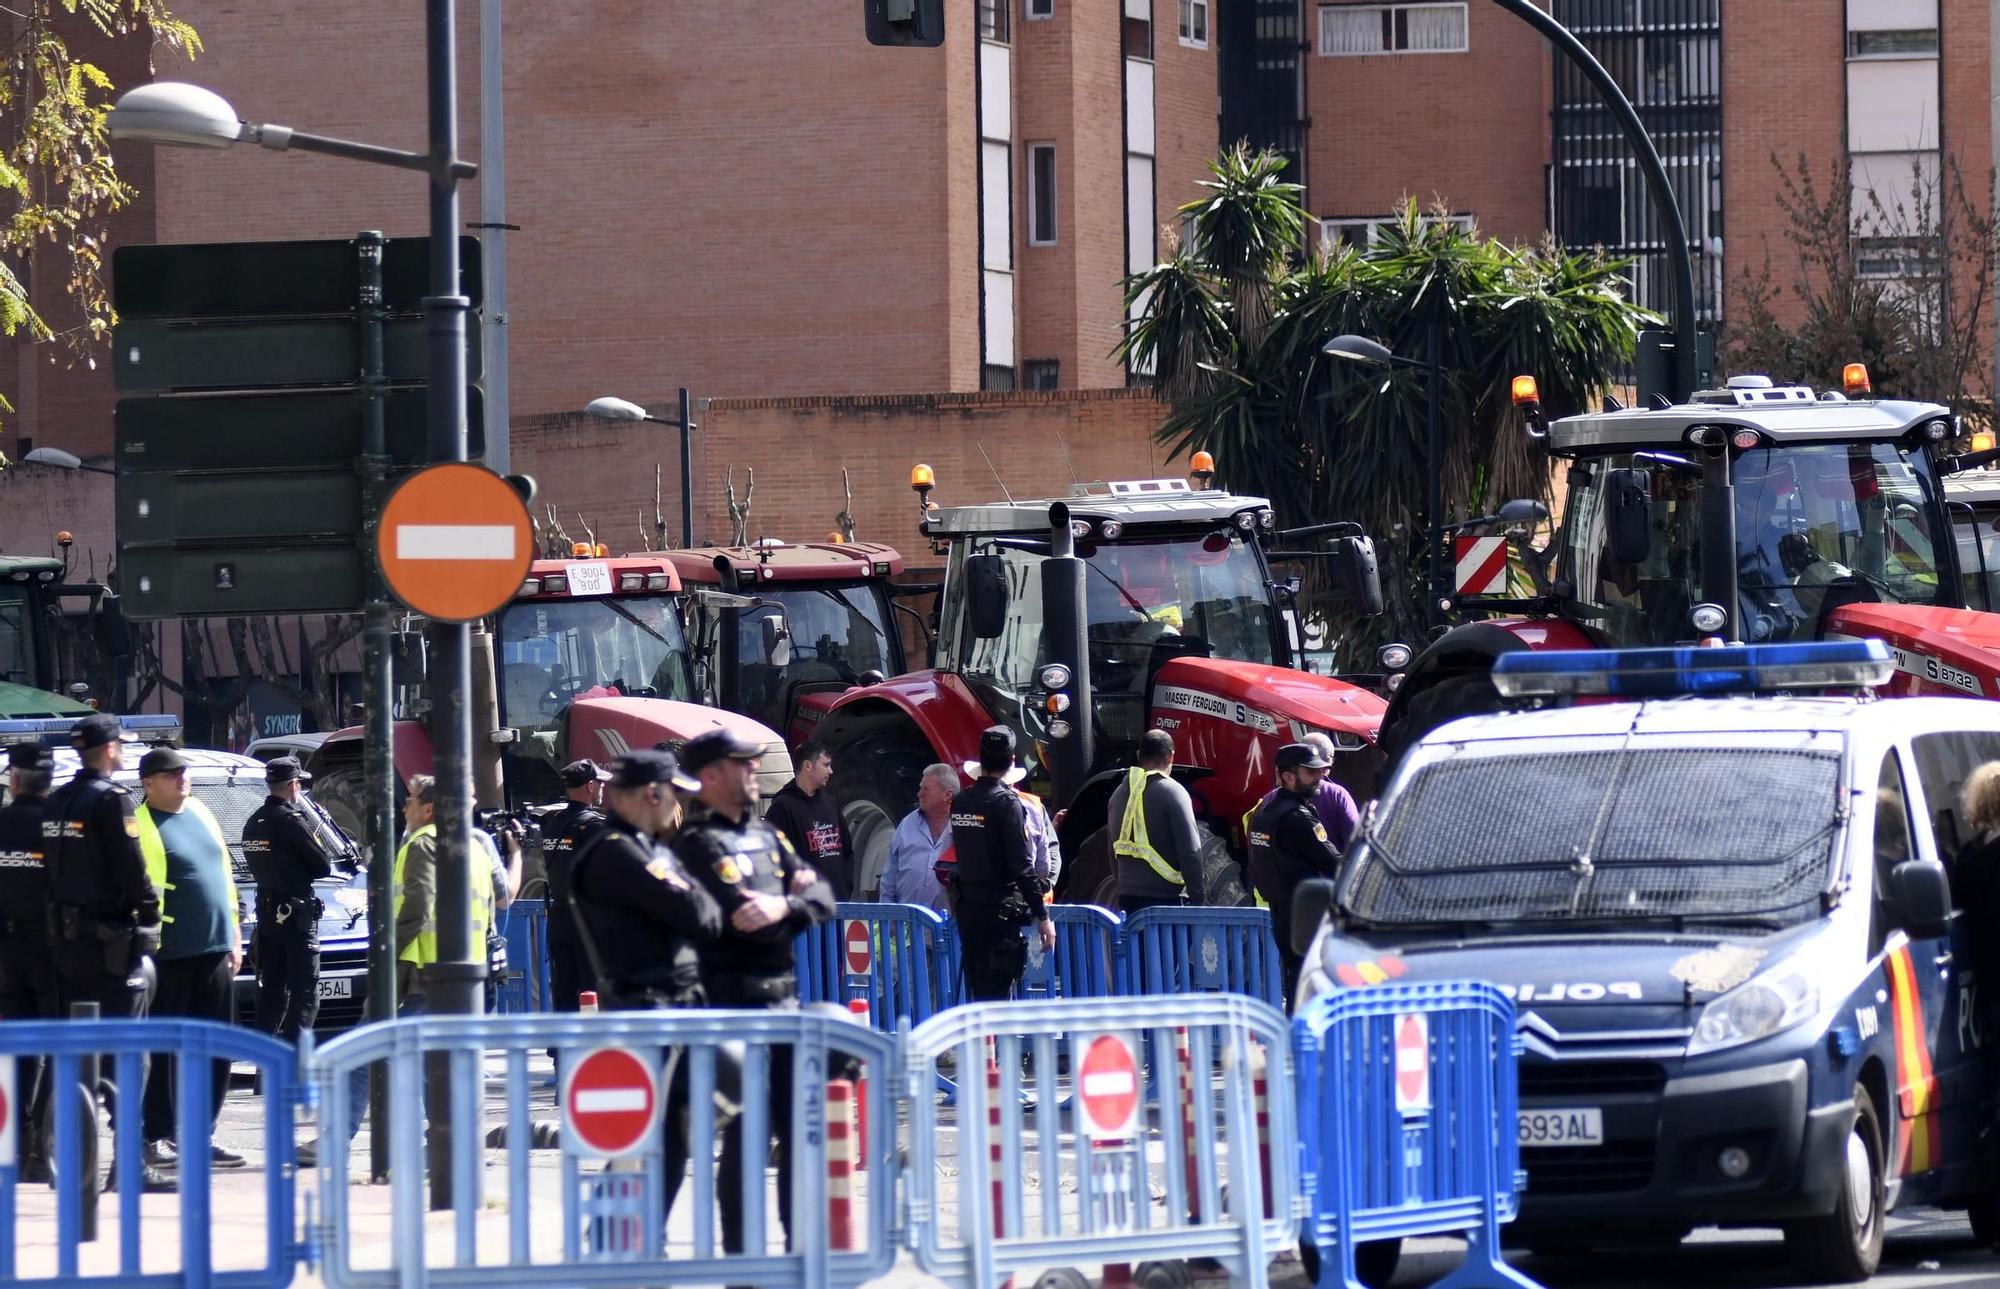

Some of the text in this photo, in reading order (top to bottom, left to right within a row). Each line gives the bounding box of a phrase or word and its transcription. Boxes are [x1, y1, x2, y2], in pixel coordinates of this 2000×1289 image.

[1927, 658, 1938, 679] S
[1941, 667, 1973, 689] 8732
[1165, 691, 1271, 728] MASSEY FERGUSON S 7724
[952, 813, 976, 821] POLICIA
